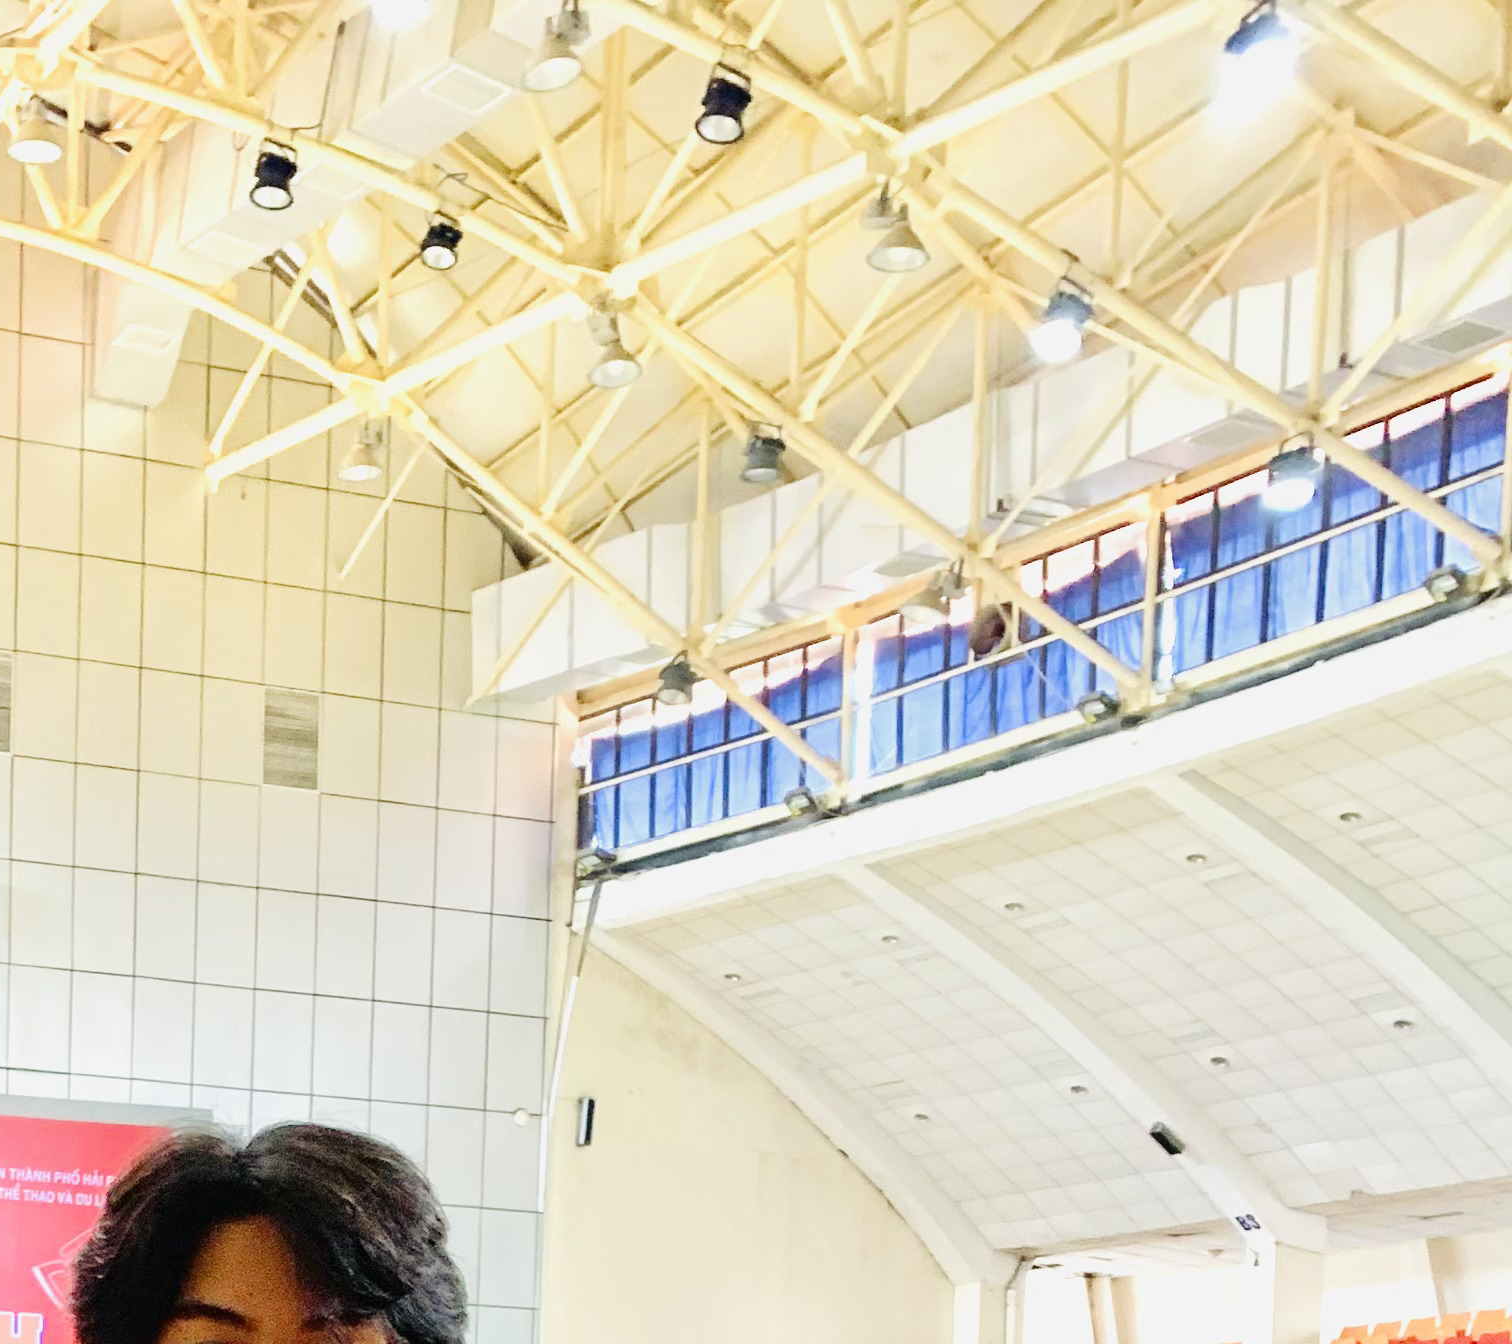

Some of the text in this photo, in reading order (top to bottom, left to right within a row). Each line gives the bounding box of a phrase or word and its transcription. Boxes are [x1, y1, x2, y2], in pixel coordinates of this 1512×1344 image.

[8, 1165, 51, 1184] THÀNH
[53, 1168, 80, 1186] PHỐ
[23, 1188, 55, 1204] THAO
[58, 1189, 74, 1205] VÀ
[75, 1191, 93, 1206] DU
